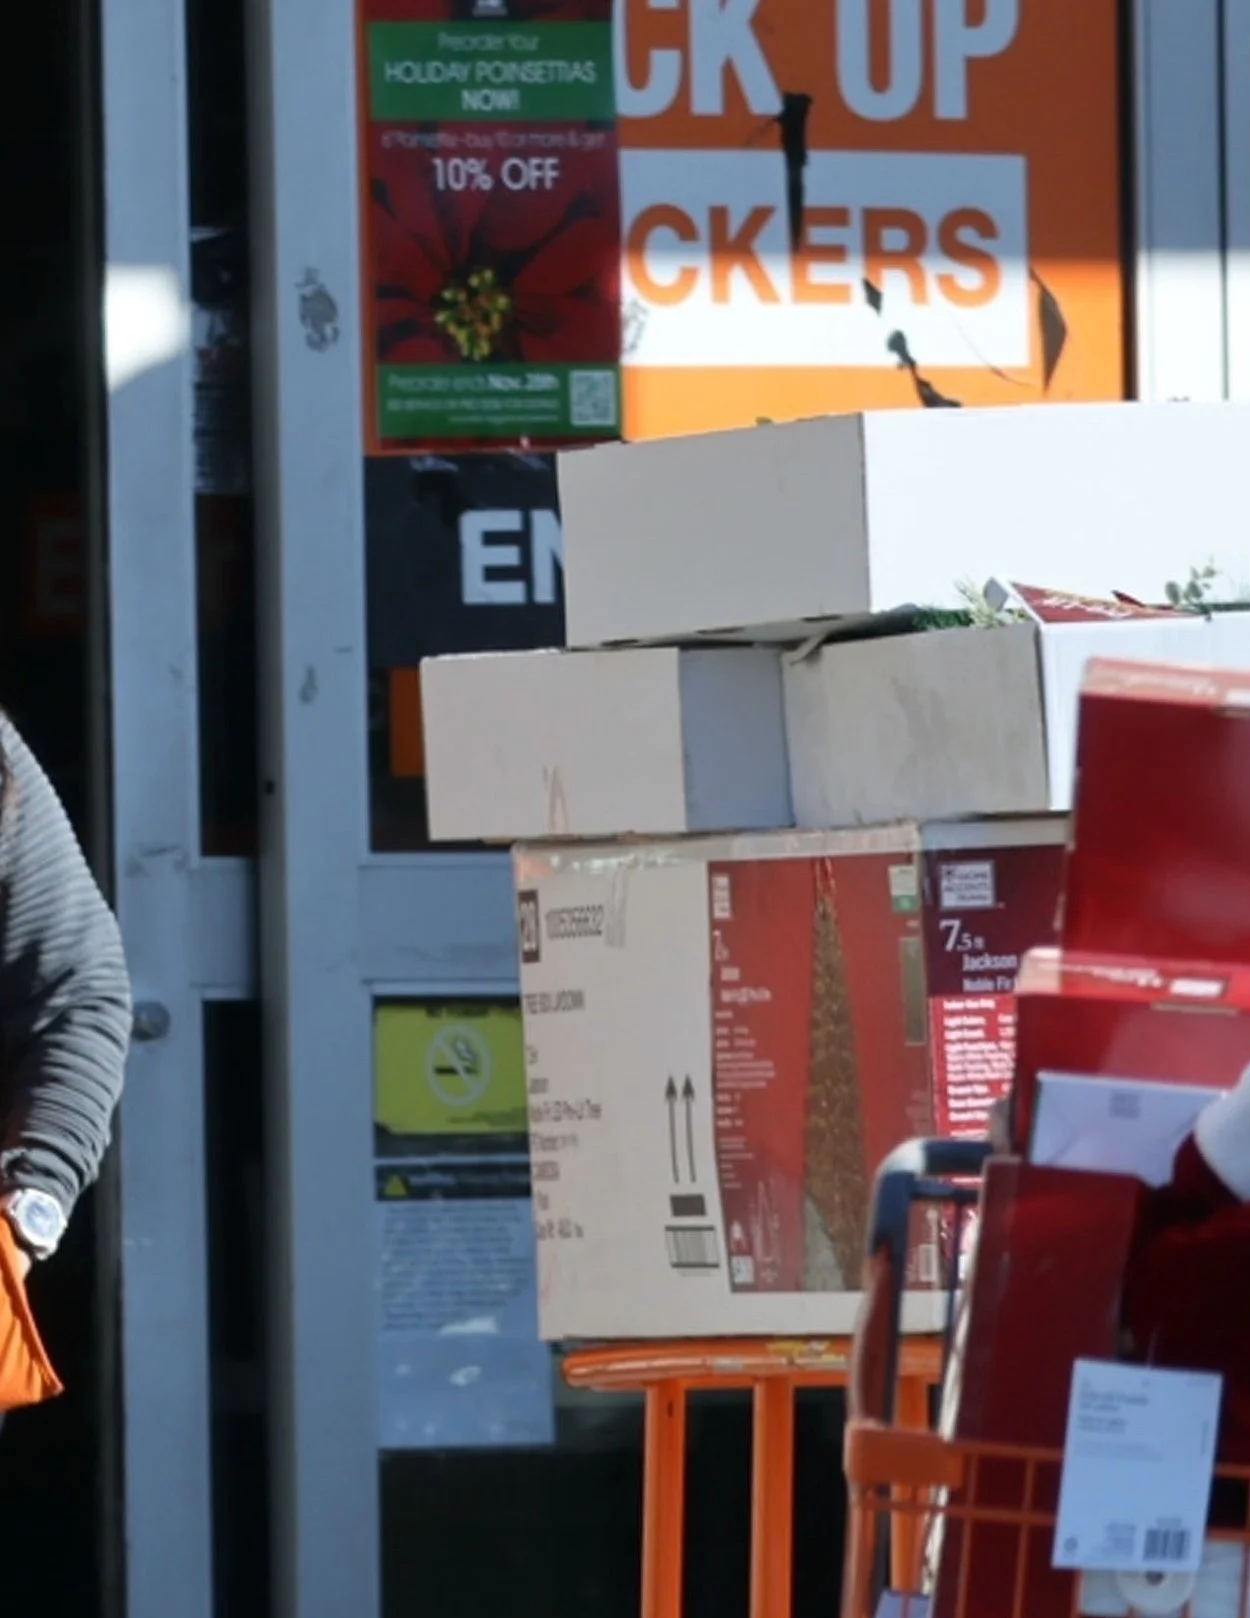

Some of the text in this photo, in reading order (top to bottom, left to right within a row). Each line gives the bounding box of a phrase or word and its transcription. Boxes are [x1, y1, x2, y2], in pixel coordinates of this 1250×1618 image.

[384, 60, 597, 84] HOLIDAY POINSETTIAS
[836, 0, 1021, 121] UP
[461, 88, 521, 111] NOW!
[432, 157, 560, 191] 10% OFF
[626, 203, 1000, 308] CKERS
